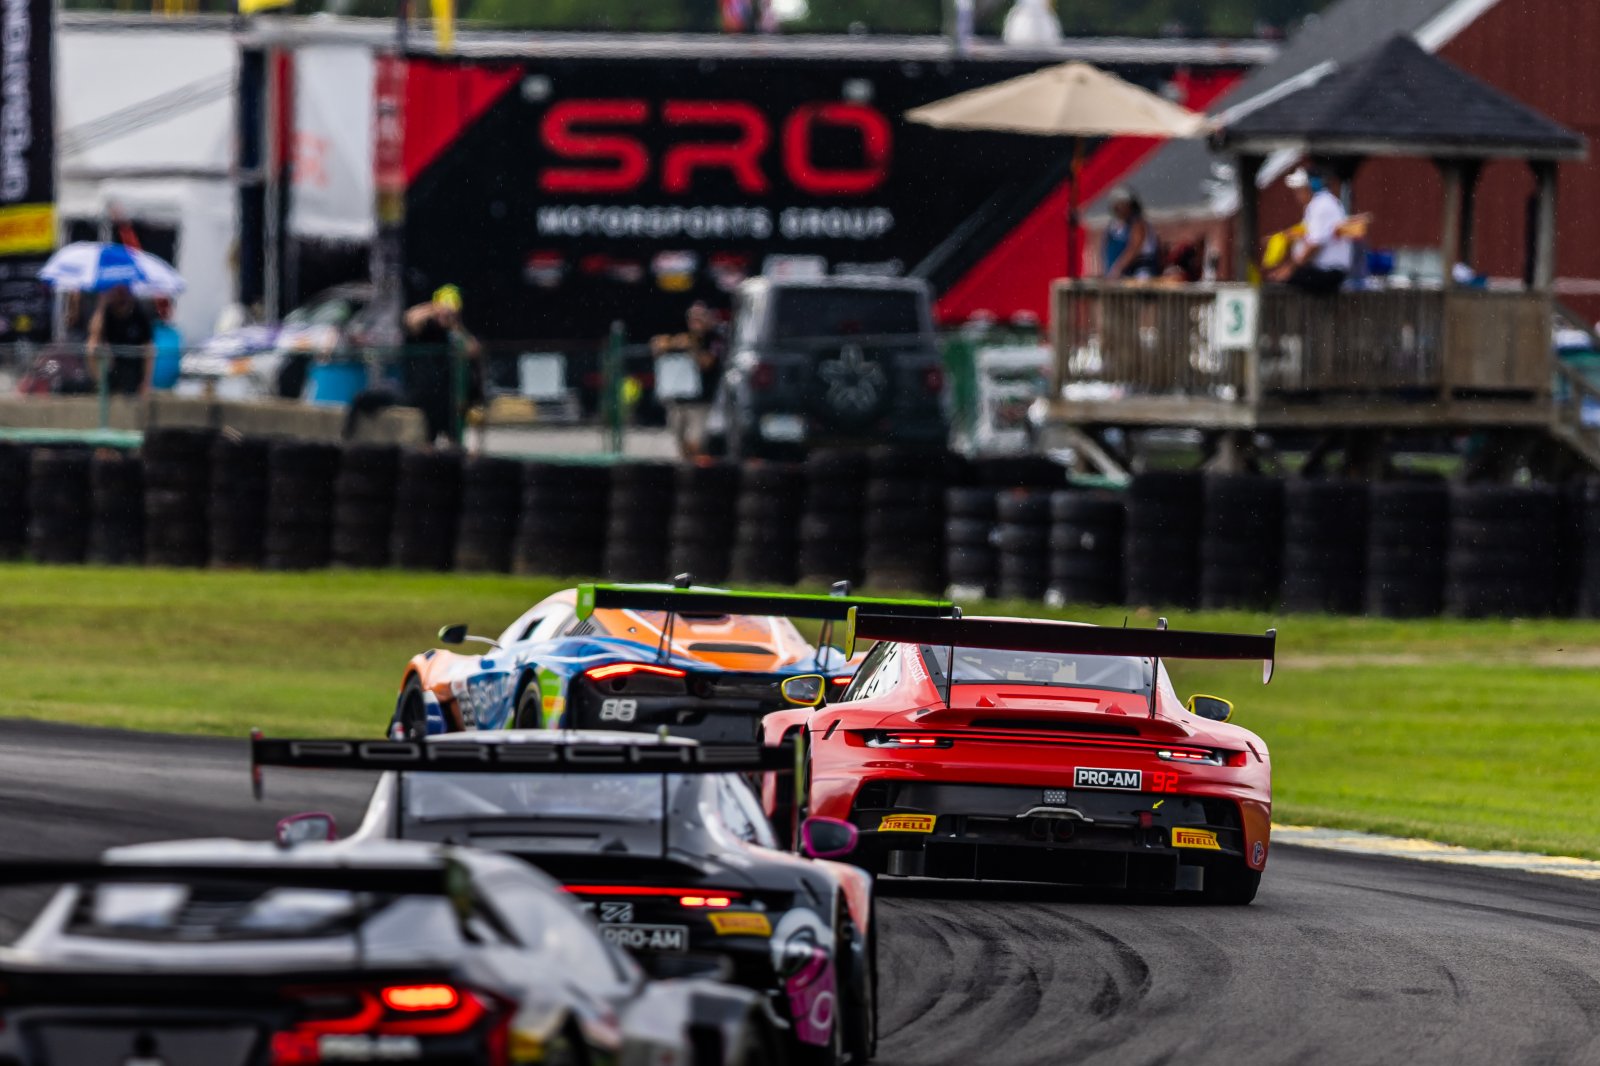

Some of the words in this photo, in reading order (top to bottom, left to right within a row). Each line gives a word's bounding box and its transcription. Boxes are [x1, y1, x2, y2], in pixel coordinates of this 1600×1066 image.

[538, 100, 894, 194] SRO
[536, 205, 773, 239] MOTORSPORTS
[779, 206, 895, 239] GROUP
[1226, 299, 1245, 336] 3
[290, 740, 762, 766] PORSCHE
[1078, 770, 1137, 787] PRO-AM
[1152, 772, 1179, 792] 92
[881, 816, 932, 831] PIRELLI
[1176, 831, 1217, 846] PIRELLI
[604, 928, 681, 948] PRO-AM
